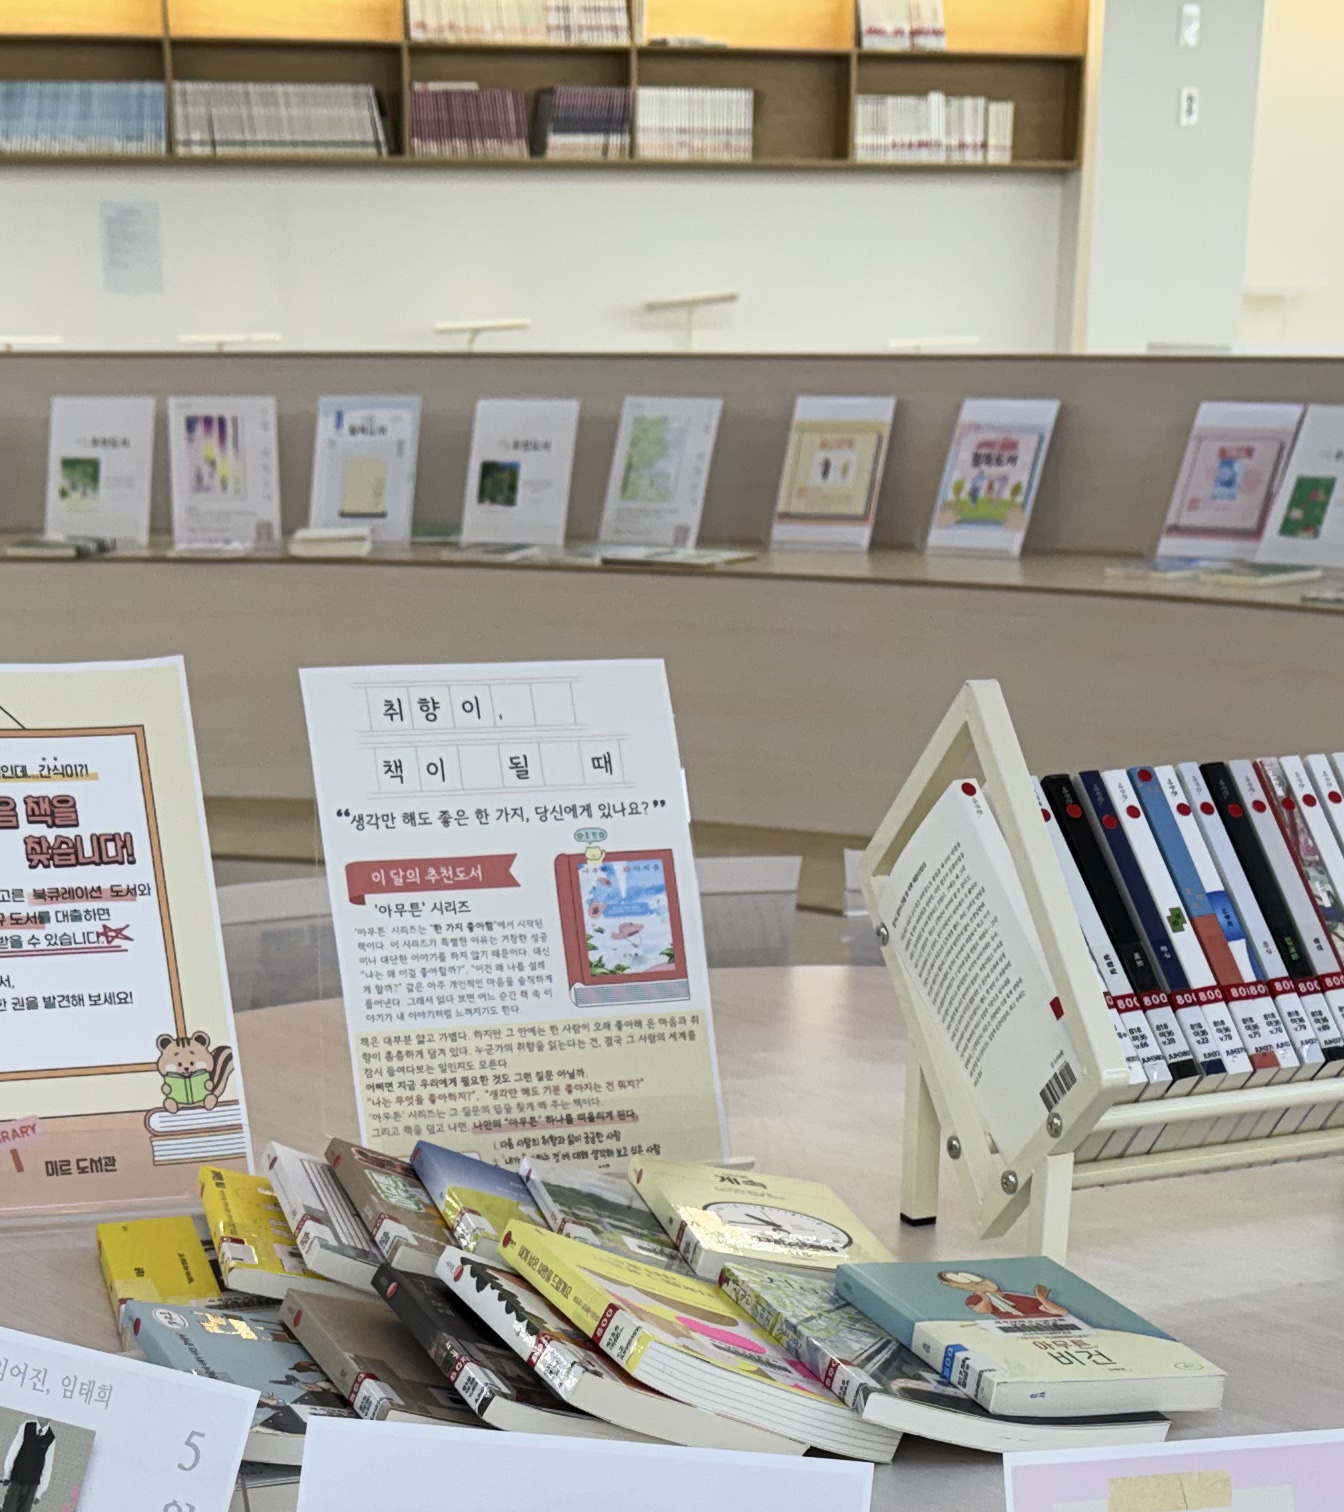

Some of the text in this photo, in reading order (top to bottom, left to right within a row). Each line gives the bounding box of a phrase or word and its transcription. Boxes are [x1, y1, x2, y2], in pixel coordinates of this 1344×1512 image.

[506, 754, 531, 779] 될
[590, 751, 614, 774] 때
[22, 794, 79, 828] 책을
[336, 799, 665, 831] “생각만 해도 좋은 한 가지, 당신에게 있나요?”
[22, 831, 136, 869] 찾습니다!
[371, 863, 482, 886] 이 달의 추천도서
[32, 885, 104, 902] 북큐레이션
[109, 882, 151, 898] 도서와
[6, 910, 50, 925] 도서를
[54, 907, 110, 923] 대출하면
[374, 900, 471, 917] '아무튼' 시리즈
[27, 934, 41, 948] 수
[43, 930, 104, 947] 있습니다.
[11, 995, 38, 1011] 권을
[42, 993, 85, 1009] 발견해
[88, 991, 133, 1006] 보세요!
[1143, 993, 1167, 1006] 800
[1199, 990, 1222, 1001] 800
[44, 1155, 117, 1176] 미르 도서관
[597, 1308, 613, 1337] 800
[1047, 1350, 1117, 1366] 비건
[61, 1374, 112, 1410] 임태희
